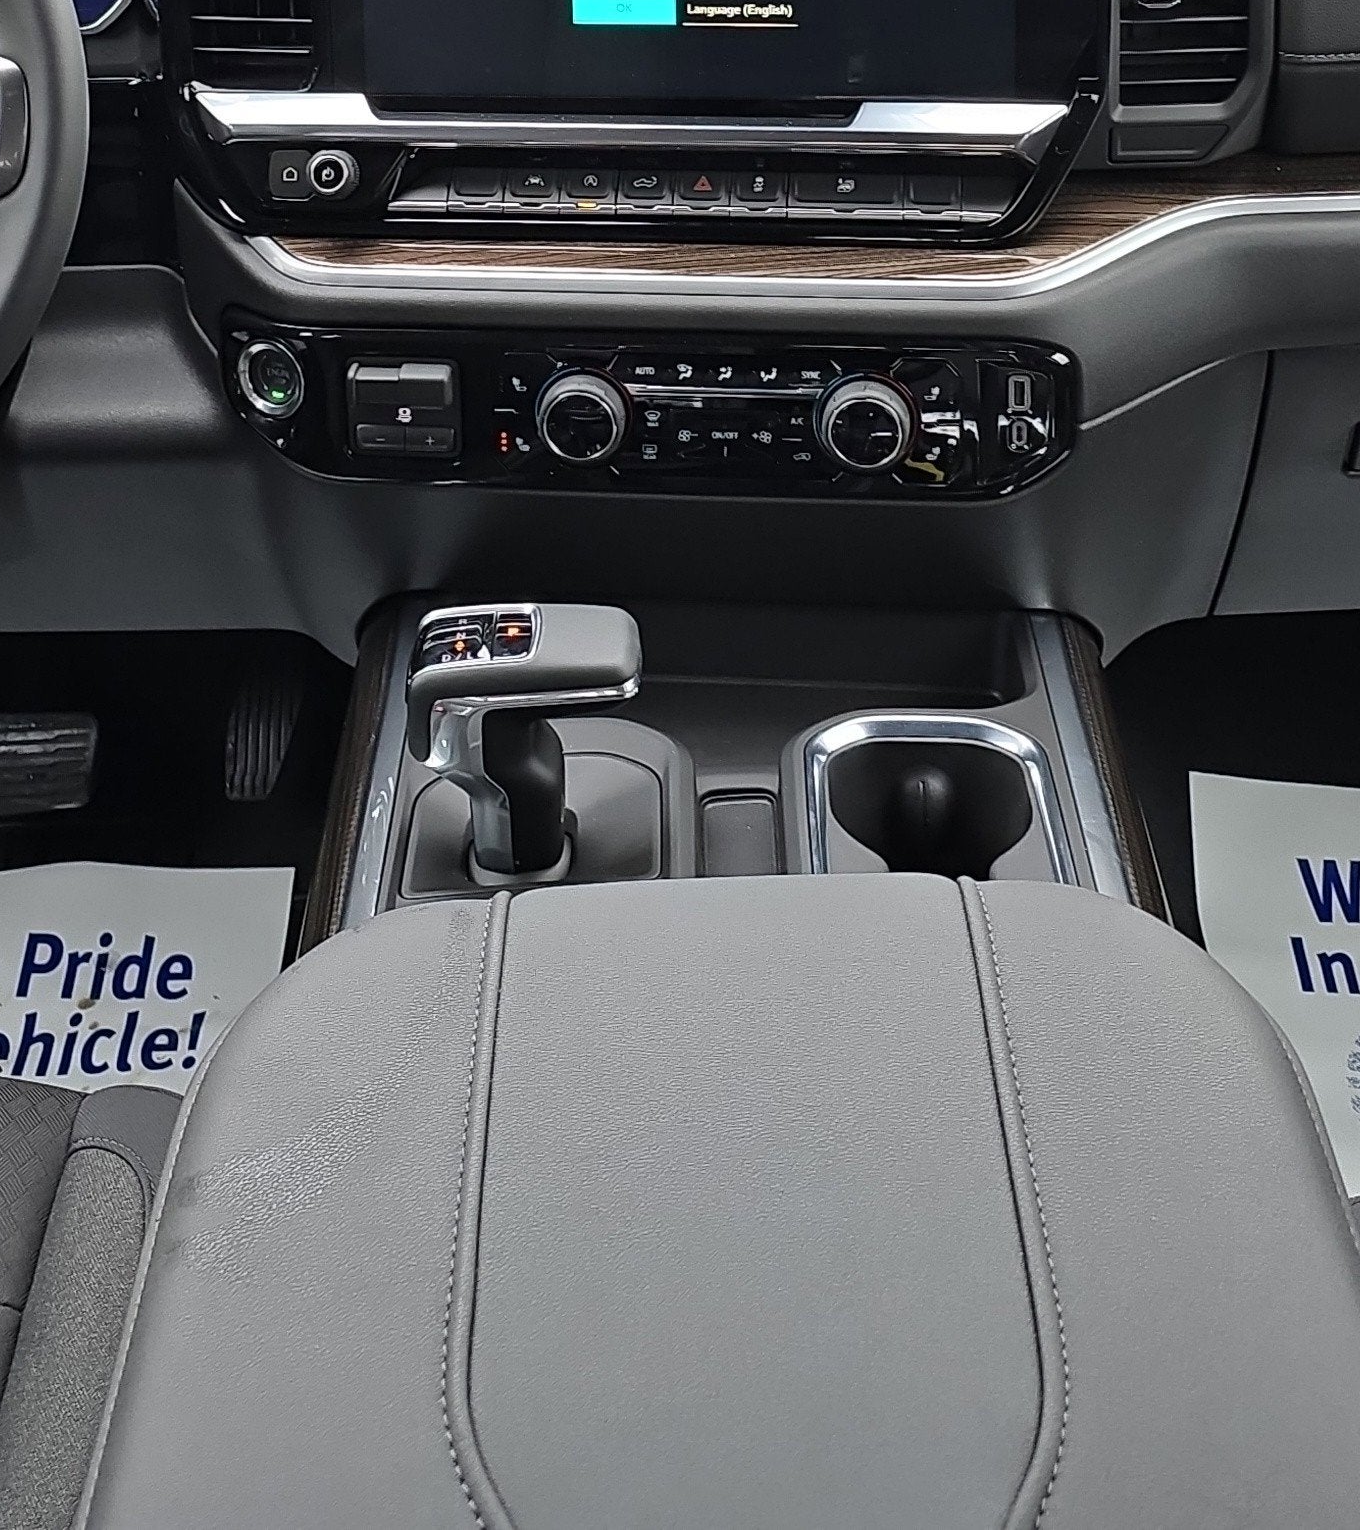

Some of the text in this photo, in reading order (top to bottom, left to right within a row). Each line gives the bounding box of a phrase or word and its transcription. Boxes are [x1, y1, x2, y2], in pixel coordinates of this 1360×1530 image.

[616, 3, 793, 18] OK Language (English)
[635, 366, 656, 376] AUTO
[801, 370, 822, 380] SYNC
[711, 431, 739, 440] ON/OFF
[15, 932, 194, 1001] Pride
[1291, 936, 1360, 995] In
